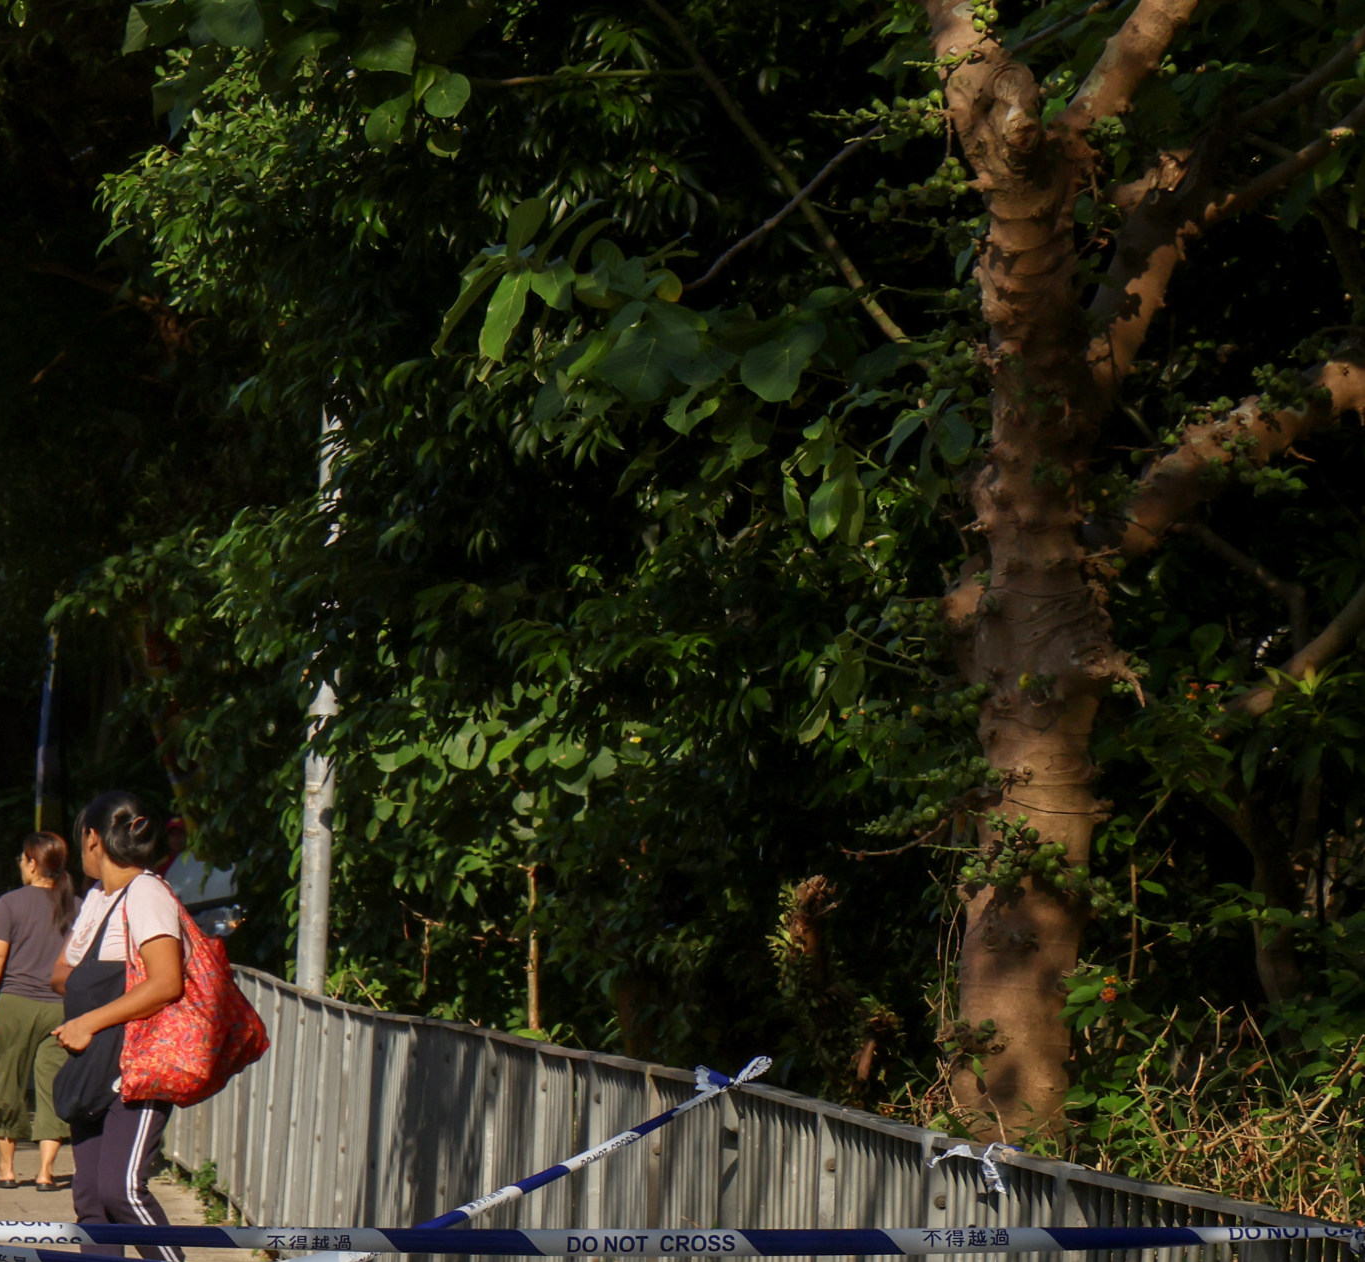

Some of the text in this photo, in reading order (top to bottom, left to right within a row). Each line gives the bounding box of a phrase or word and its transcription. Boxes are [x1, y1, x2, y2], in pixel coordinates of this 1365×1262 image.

[267, 1235, 352, 1250] 不得越過
[567, 1234, 736, 1253] DO NOT CROSS
[922, 1229, 1010, 1248] 不得越過
